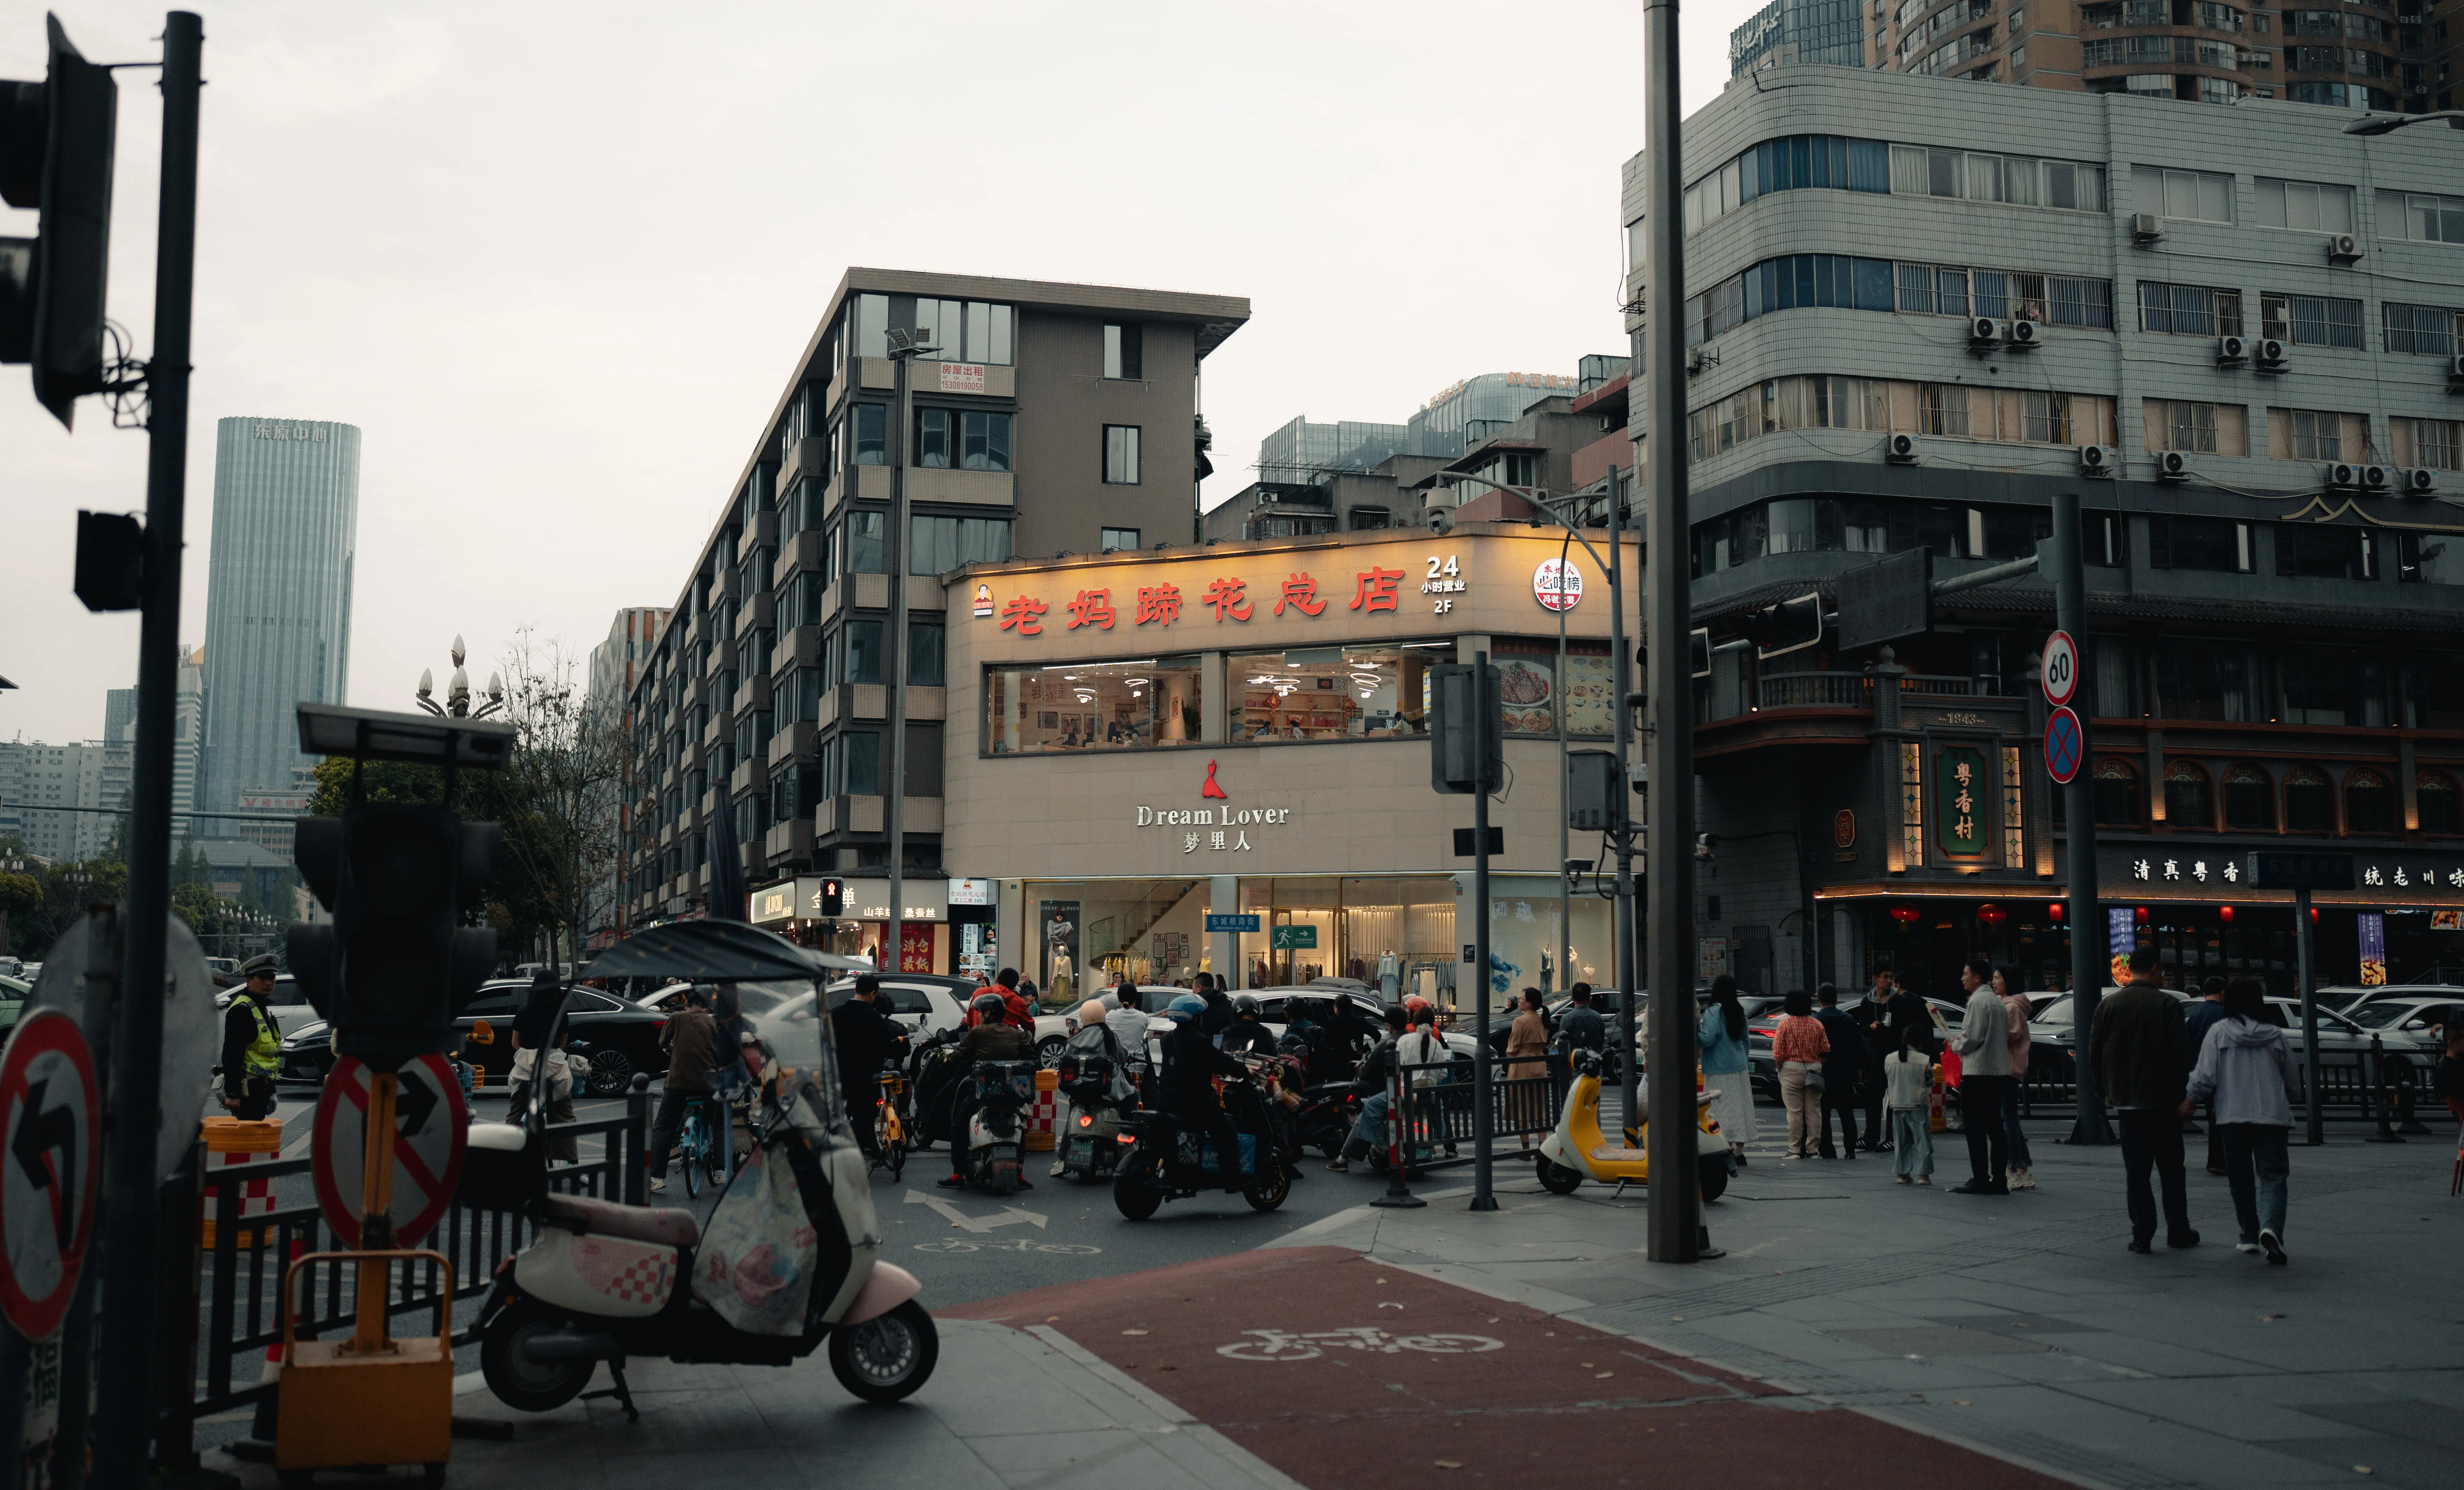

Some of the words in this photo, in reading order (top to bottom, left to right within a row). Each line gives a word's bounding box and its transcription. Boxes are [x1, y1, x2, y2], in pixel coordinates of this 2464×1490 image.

[942, 365, 983, 376] 房屋出租
[942, 380, 983, 391] 15308190058
[255, 424, 327, 443] 东原中心
[1427, 555, 1459, 578] 24
[1421, 580, 1465, 593] 小时营业
[1000, 566, 1405, 635] 老妈蹄花总店
[1434, 600, 1452, 613] 2F
[2049, 652, 2069, 684] 60
[1137, 806, 1213, 826] Dream
[1220, 805, 1289, 825] Lover
[1184, 830, 1251, 853] 梦里人
[904, 908, 936, 918] 桑蚕丝
[1211, 916, 1255, 926] 东城根南街
[903, 938, 929, 954] 清仓
[903, 955, 929, 972] 最低
